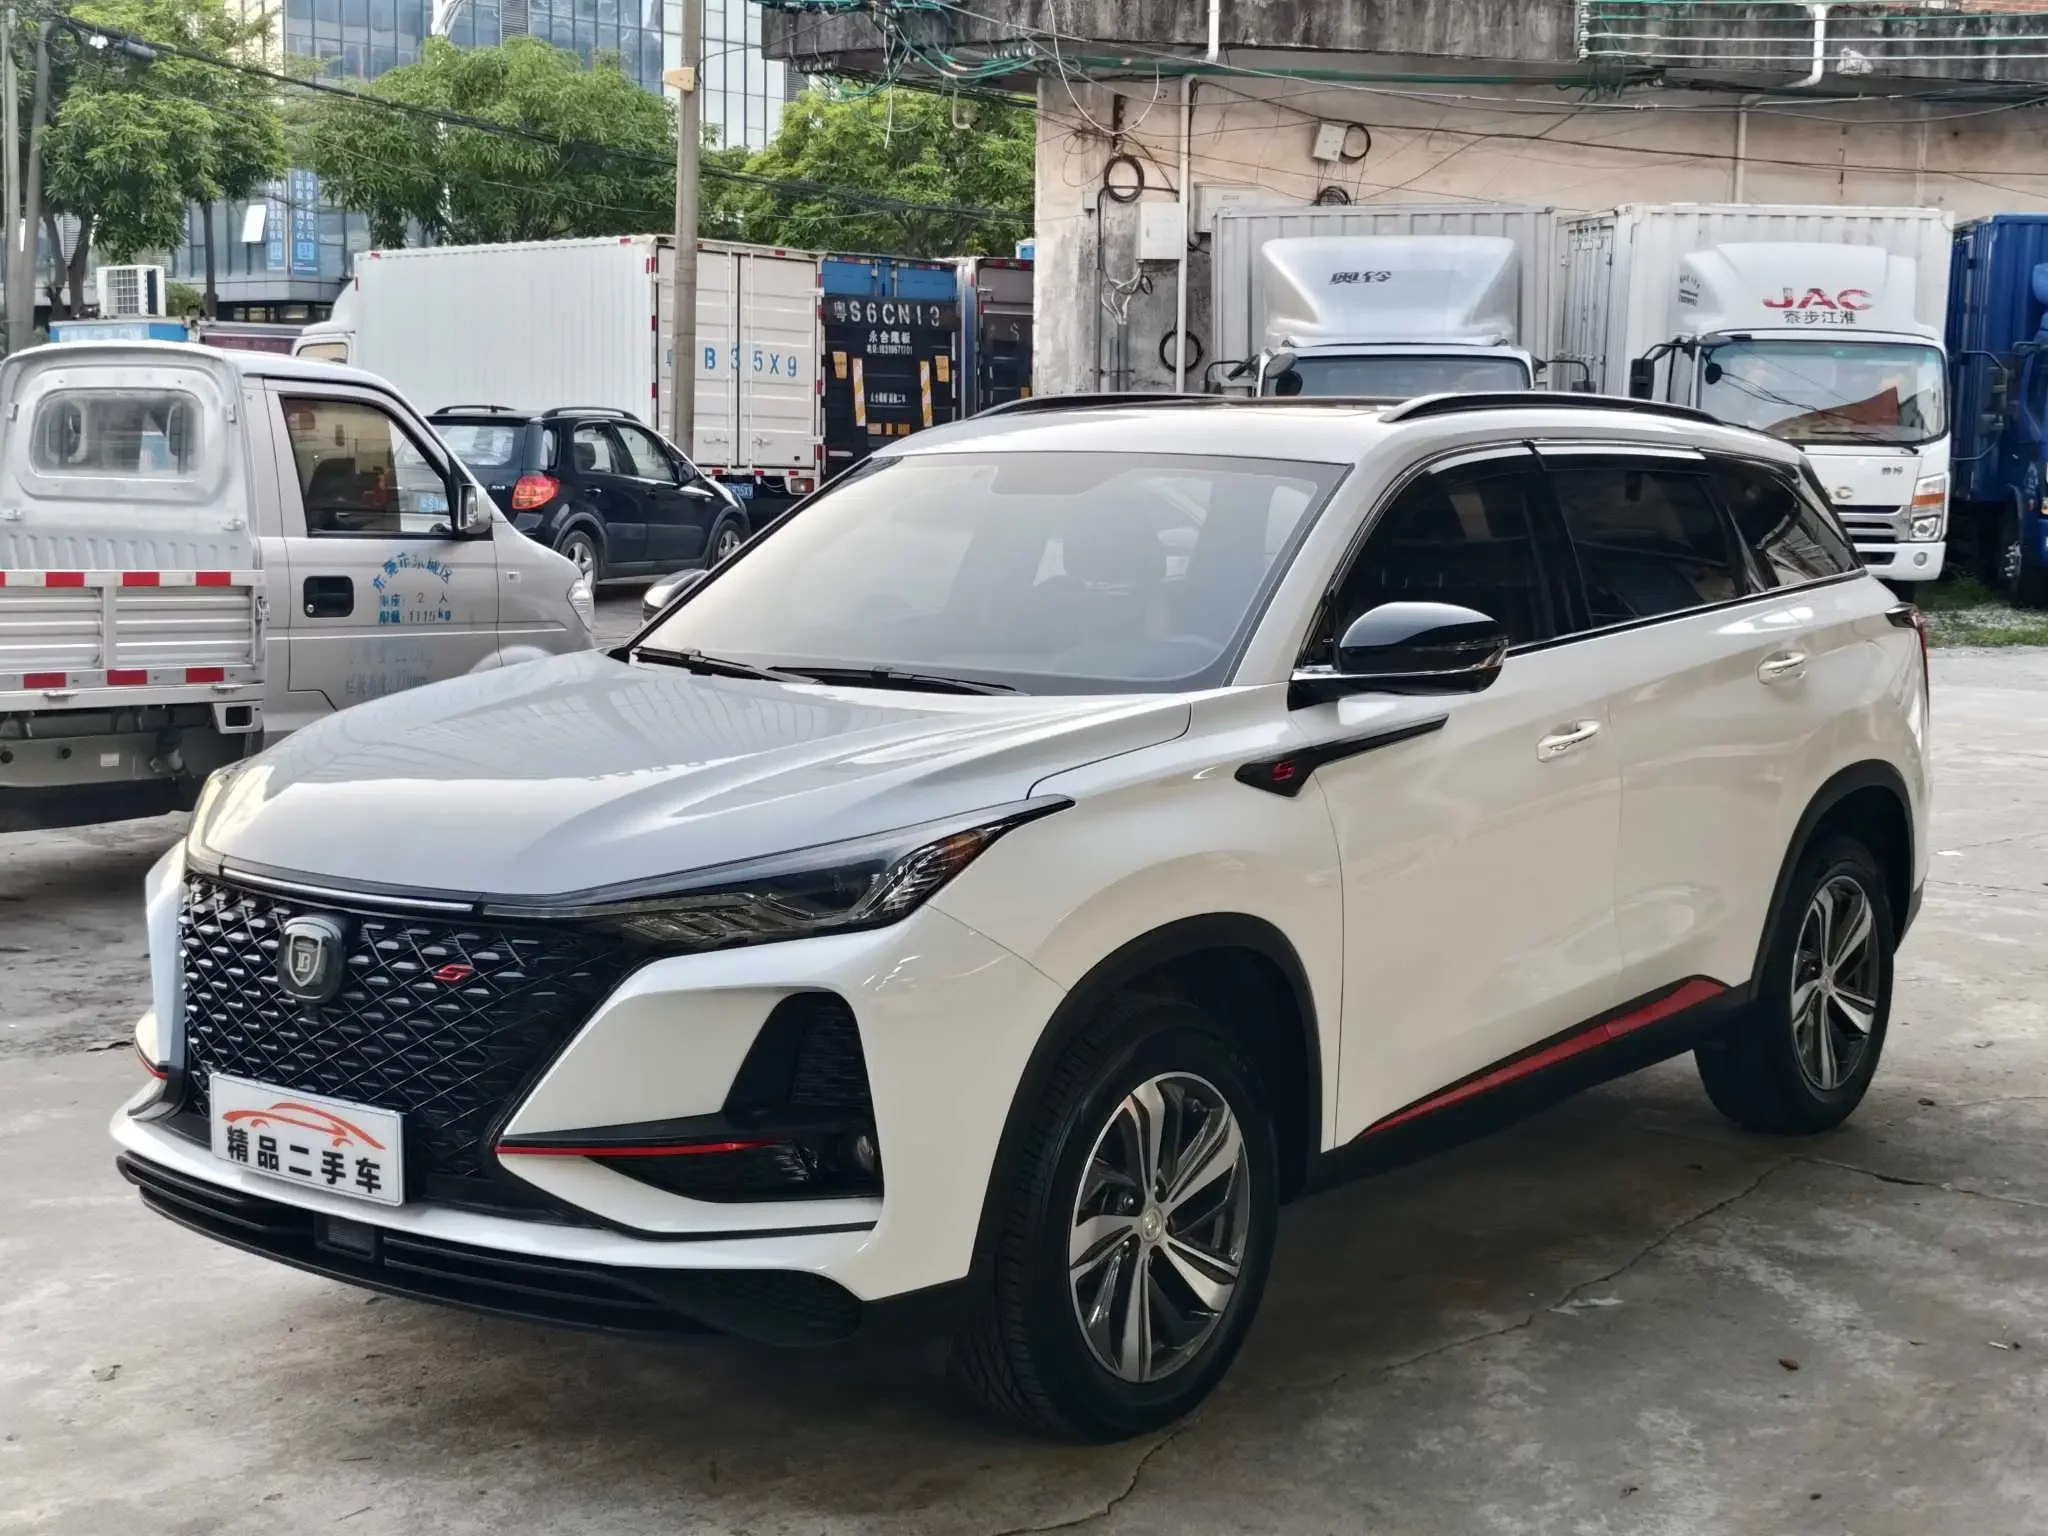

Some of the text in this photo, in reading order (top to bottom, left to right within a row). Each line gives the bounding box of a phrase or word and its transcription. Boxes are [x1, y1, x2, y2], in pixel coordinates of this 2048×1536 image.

[1762, 287, 1873, 310] JAC
[227, 1126, 382, 1194] 精品二手车
